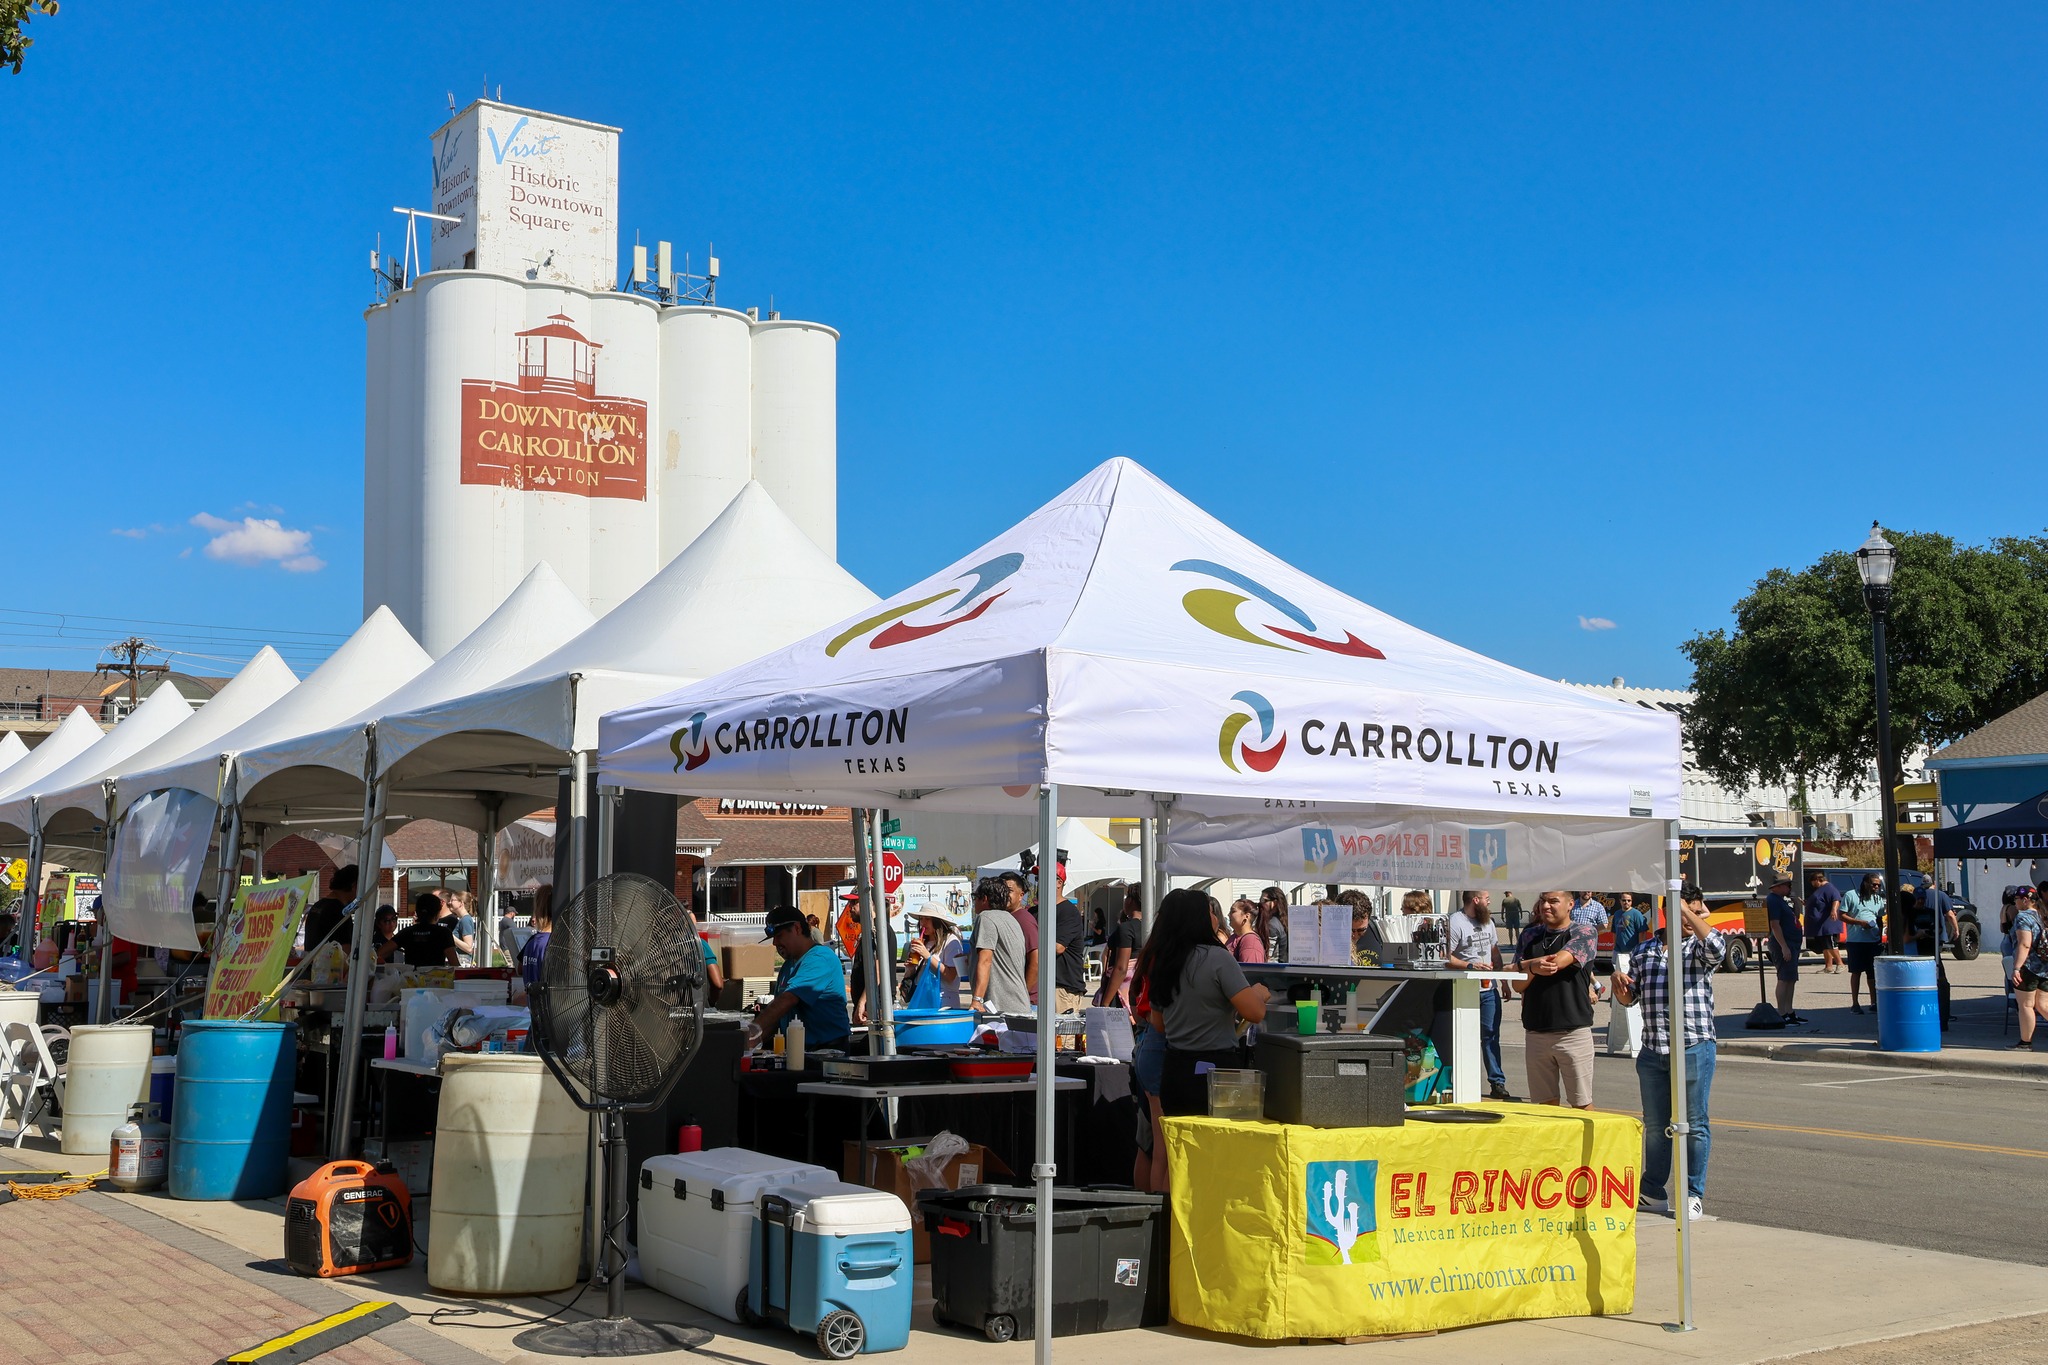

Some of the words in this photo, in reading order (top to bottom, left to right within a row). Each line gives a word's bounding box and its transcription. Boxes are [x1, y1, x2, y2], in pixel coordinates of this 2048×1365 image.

[487, 116, 561, 165] Visit
[432, 128, 463, 189] Visit
[441, 164, 471, 197] Historic
[510, 164, 580, 193] Historic
[437, 185, 474, 215] Downtown
[509, 185, 603, 218] Downtown
[509, 206, 571, 232] Square
[478, 398, 637, 437] DOWNTOWN
[513, 463, 600, 486] STATION
[714, 707, 909, 755] CARROLLTON
[1300, 719, 1560, 774] CARROLLTON
[844, 756, 906, 774] TEXAS
[1492, 780, 1562, 798] TEXAS
[867, 836, 906, 850] Badway
[870, 865, 902, 882] OP
[247, 913, 275, 939] TACOS
[343, 1189, 383, 1200] GENERAC
[1390, 1172, 1435, 1219] EL
[1449, 1165, 1635, 1216] RINCON
[1393, 1227, 1456, 1244] Mexican
[1461, 1220, 1518, 1239] Kitchen
[1523, 1218, 1533, 1233] &
[1538, 1217, 1597, 1239] Tequila
[1605, 1216, 1632, 1232] Ba
[1367, 1261, 1577, 1301] www.elrincontx.com
